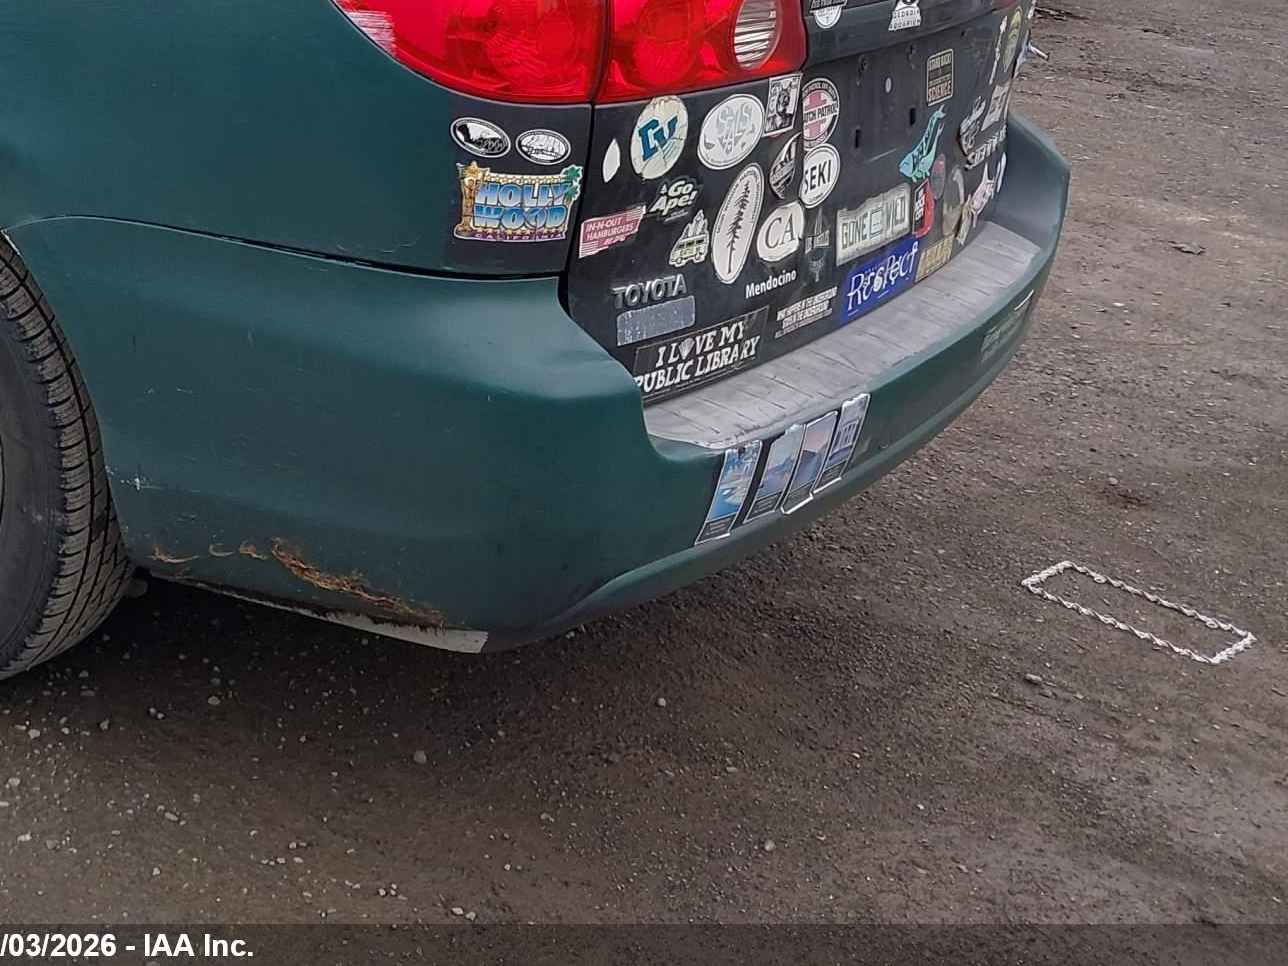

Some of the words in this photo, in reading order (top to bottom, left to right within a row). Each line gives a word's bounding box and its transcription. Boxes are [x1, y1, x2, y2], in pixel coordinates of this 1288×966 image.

[889, 19, 921, 30] AQUARIUM
[893, 10, 920, 19] GEORGIA
[668, 180, 693, 197] Go
[804, 159, 832, 194] SEKI
[476, 183, 571, 206] HOLLY
[649, 191, 697, 215] Ape!
[473, 205, 567, 229] WOOD
[586, 217, 622, 232] IN-N-OUT
[586, 223, 634, 241] HAMBURGERS
[765, 212, 795, 248] CA
[612, 273, 687, 309] TOYOTA
[745, 269, 796, 299] Mendocino
[655, 345, 666, 368] I
[719, 321, 744, 346] MY
[634, 359, 694, 393] PUBLIC
[695, 336, 760, 376] LIBRARY
